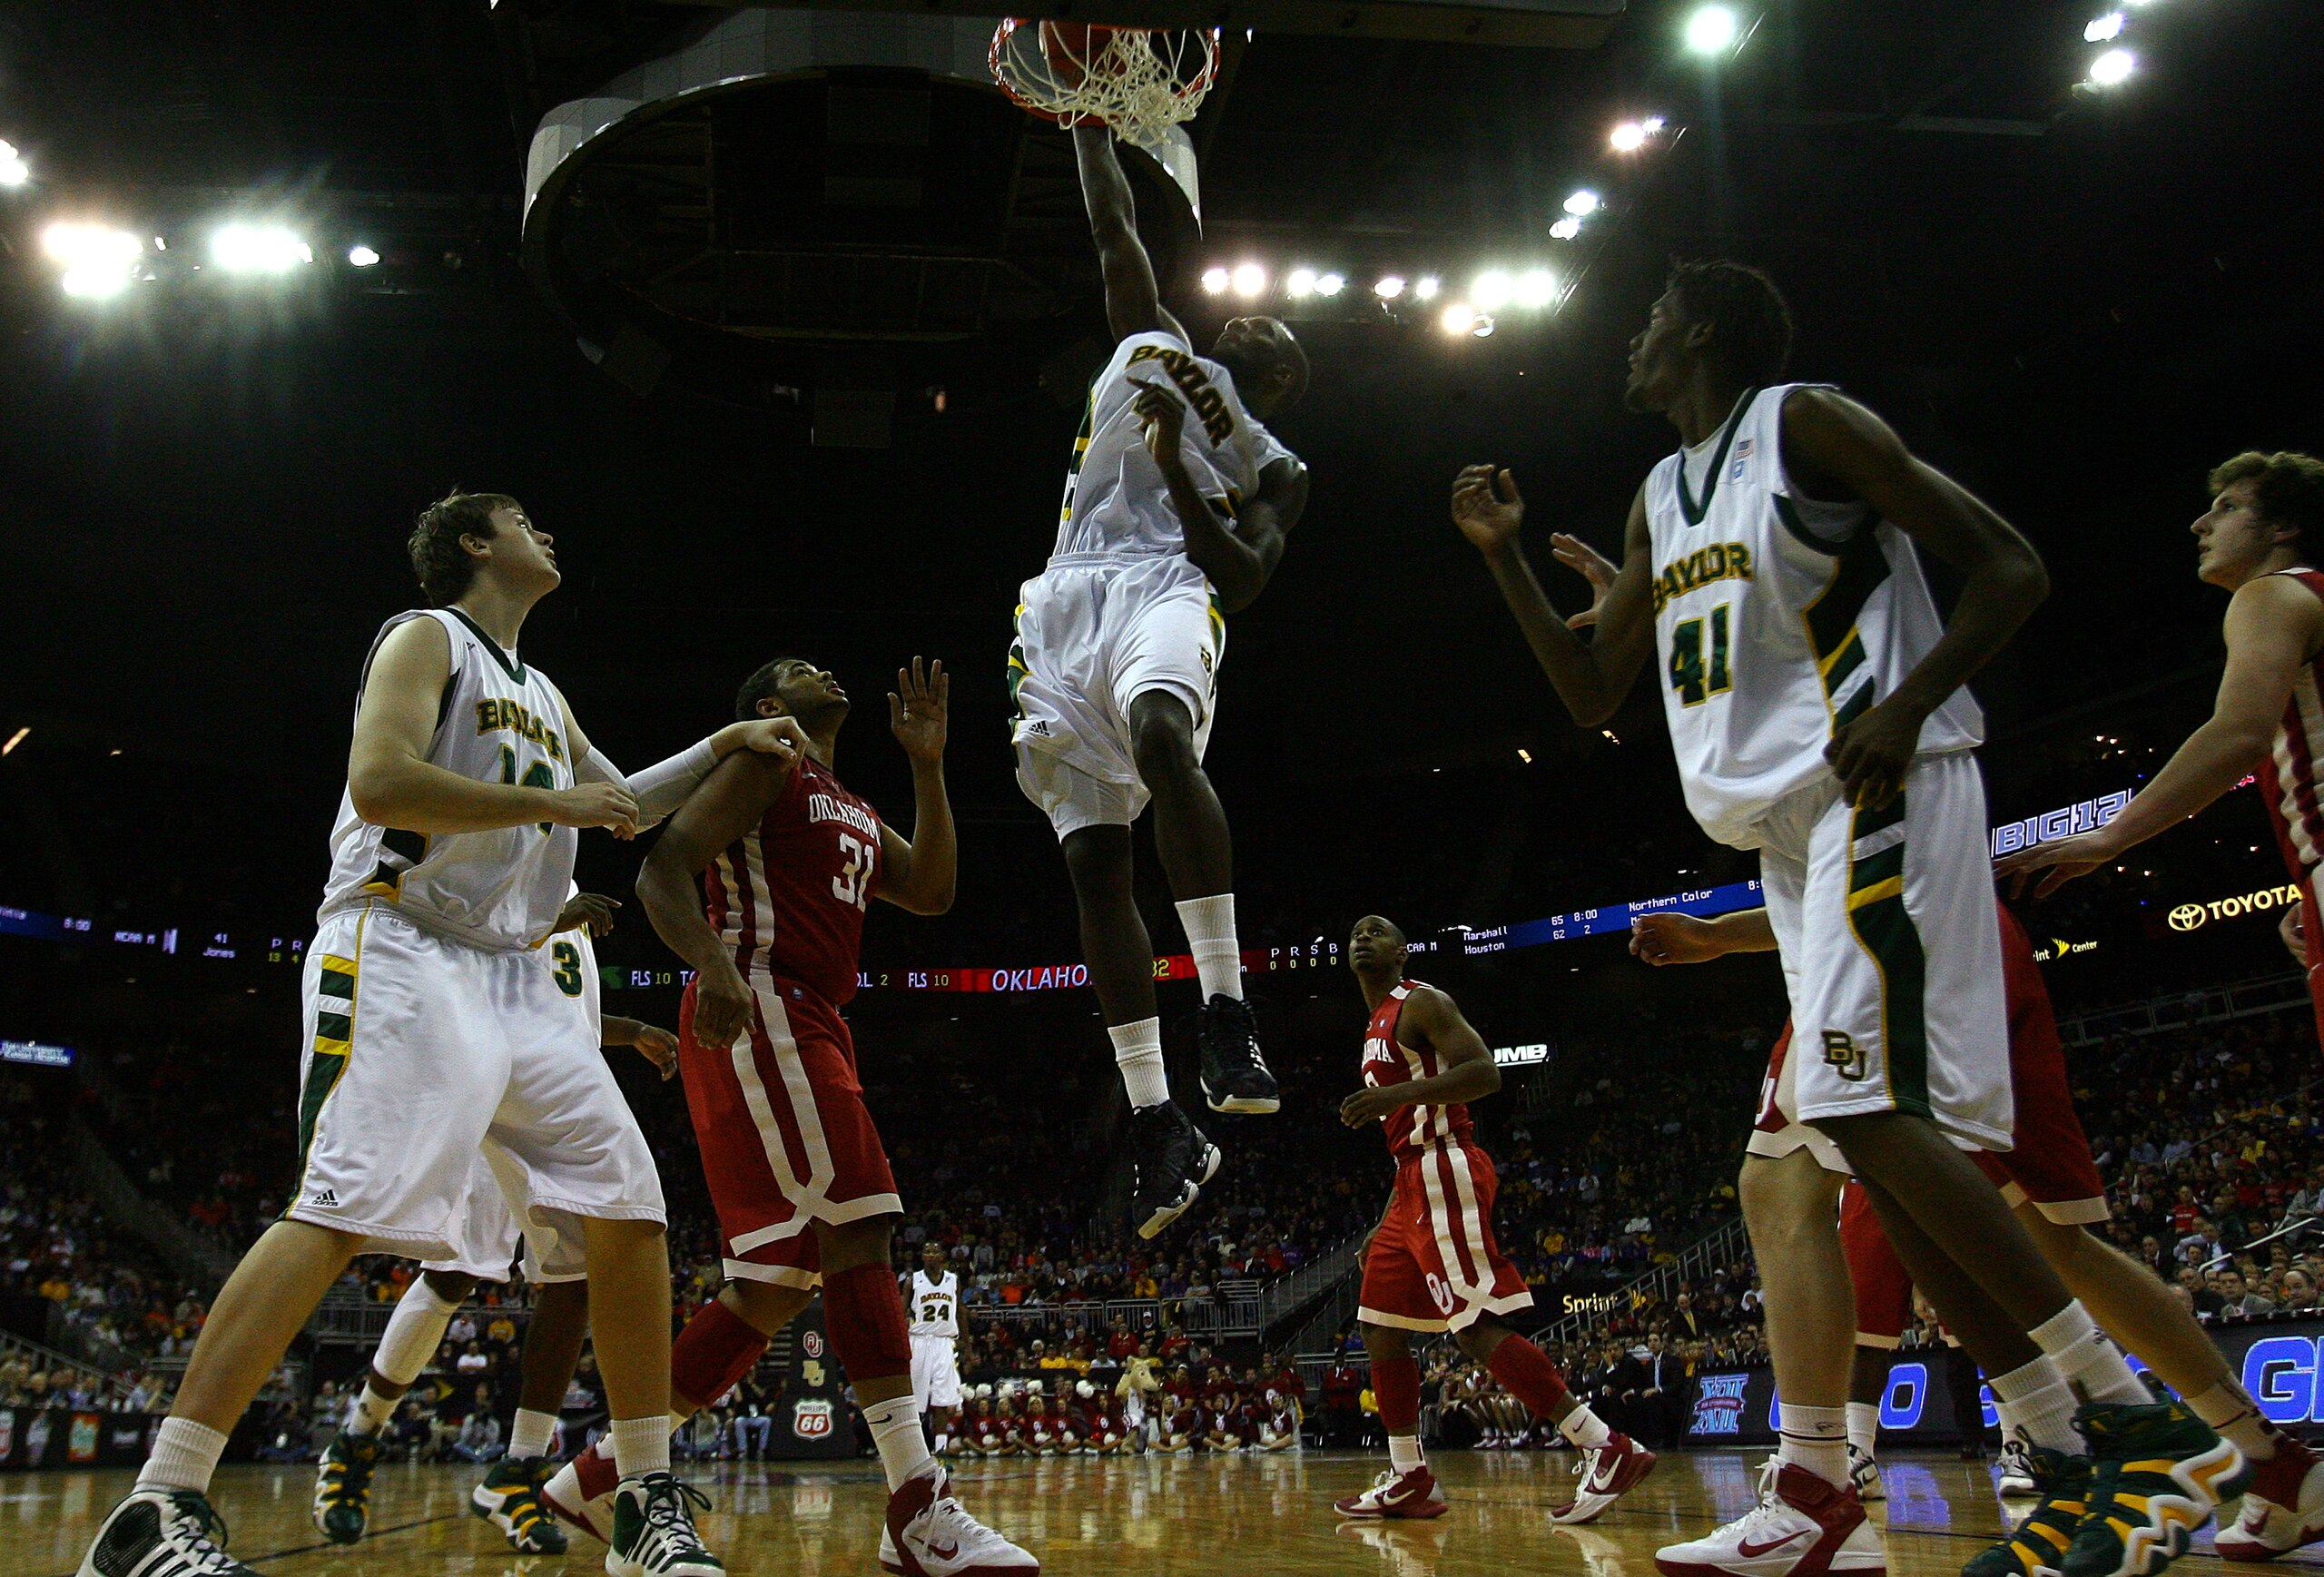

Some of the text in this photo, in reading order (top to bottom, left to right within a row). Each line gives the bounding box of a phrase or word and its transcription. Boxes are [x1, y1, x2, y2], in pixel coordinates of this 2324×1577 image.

[1125, 345, 1235, 450] BAYLOR
[1670, 602, 1733, 708] 41
[832, 832, 874, 913] 31
[1629, 893, 1678, 912] Northern
[1681, 889, 1713, 903] Color
[2207, 883, 2303, 921] TOYOTA
[1551, 909, 1598, 927] 65 8:00
[1463, 925, 1508, 941] Marshall
[1552, 925, 1591, 941] 62 2
[272, 937, 303, 952] P R
[1271, 943, 1338, 959] P R S B
[1464, 943, 1505, 956] Houston
[2072, 941, 2099, 952] Center
[552, 941, 583, 997] 3
[1270, 956, 1336, 971] 0 0 0 0
[631, 971, 651, 987] FLS
[655, 972, 671, 985] 10
[880, 974, 888, 986] 2
[908, 972, 927, 988] FLS
[934, 974, 949, 987] 10
[992, 963, 1093, 992] OKLAHO
[1821, 1030, 1866, 1081] BU
[1425, 1272, 1453, 1316] OU
[922, 1305, 950, 1322] 24
[799, 1415, 825, 1433] 66
